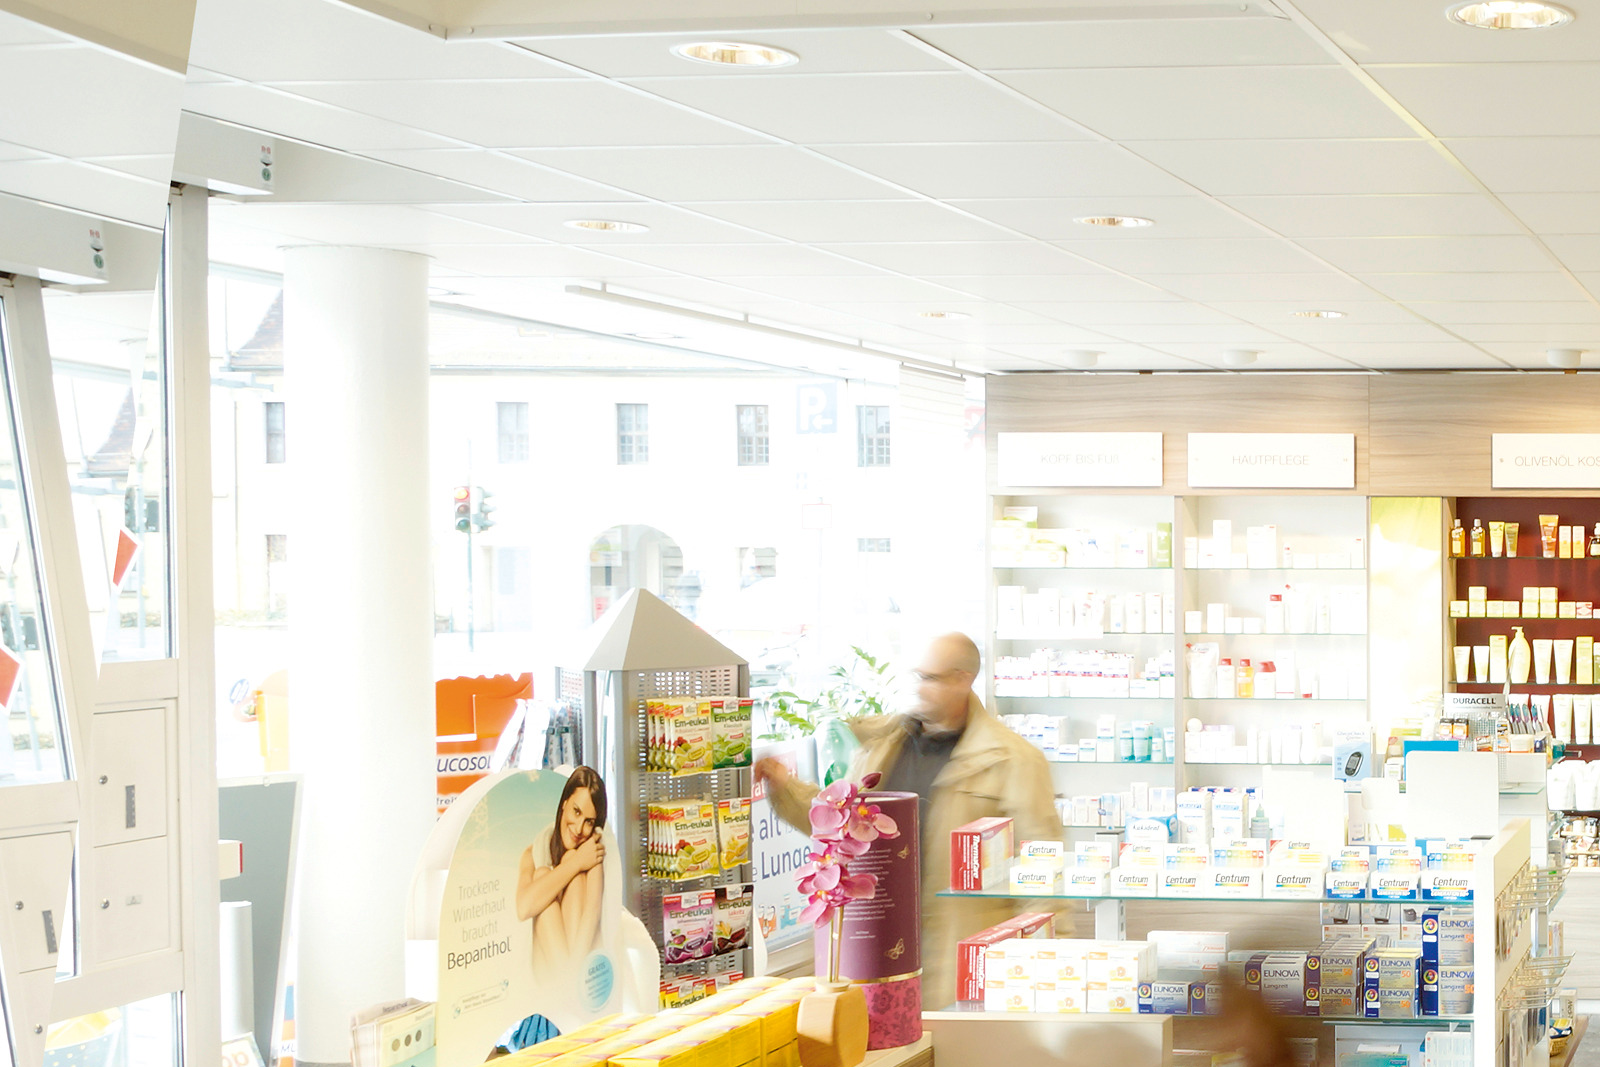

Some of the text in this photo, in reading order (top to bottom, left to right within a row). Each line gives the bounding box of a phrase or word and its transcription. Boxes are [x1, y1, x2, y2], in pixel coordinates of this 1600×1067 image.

[1041, 454, 1072, 465] KOPF
[1074, 454, 1095, 465] BIS
[1232, 454, 1310, 466] HAUTPFLEGE
[1514, 452, 1572, 468] OLIVENÖL
[1452, 697, 1497, 705] DURACELL
[674, 717, 709, 728] Em-eukal
[714, 713, 751, 723] Em-eukal
[437, 756, 491, 772] ucosol
[723, 813, 750, 824] Em-euka
[675, 819, 712, 831] Em-eukal
[1028, 845, 1056, 855] Centrum
[971, 834, 981, 879] ThermaCare
[1017, 872, 1047, 882] Centrum
[1071, 874, 1097, 882] Centrum
[1118, 875, 1149, 884] Centrum
[1165, 875, 1197, 885] Centrum
[1215, 873, 1250, 883] Centrum
[1276, 874, 1311, 885] Centrum
[1432, 876, 1468, 887] Centrum
[1333, 879, 1360, 887] Centrum
[1379, 878, 1410, 887] Centrum
[458, 879, 500, 901] Trockene
[718, 899, 752, 910] Em-euka
[453, 898, 506, 923] Winterhaut
[669, 907, 713, 919] Em-eukal
[1441, 920, 1474, 928] EUNOVA
[462, 921, 498, 943] braucht
[447, 936, 512, 970] Bepanthol
[1264, 970, 1300, 978] EUNOVA
[1343, 968, 1353, 976] 50
[1401, 970, 1411, 978] 50
[1441, 970, 1474, 978] EUNOVA
[1341, 998, 1352, 1006] 50
